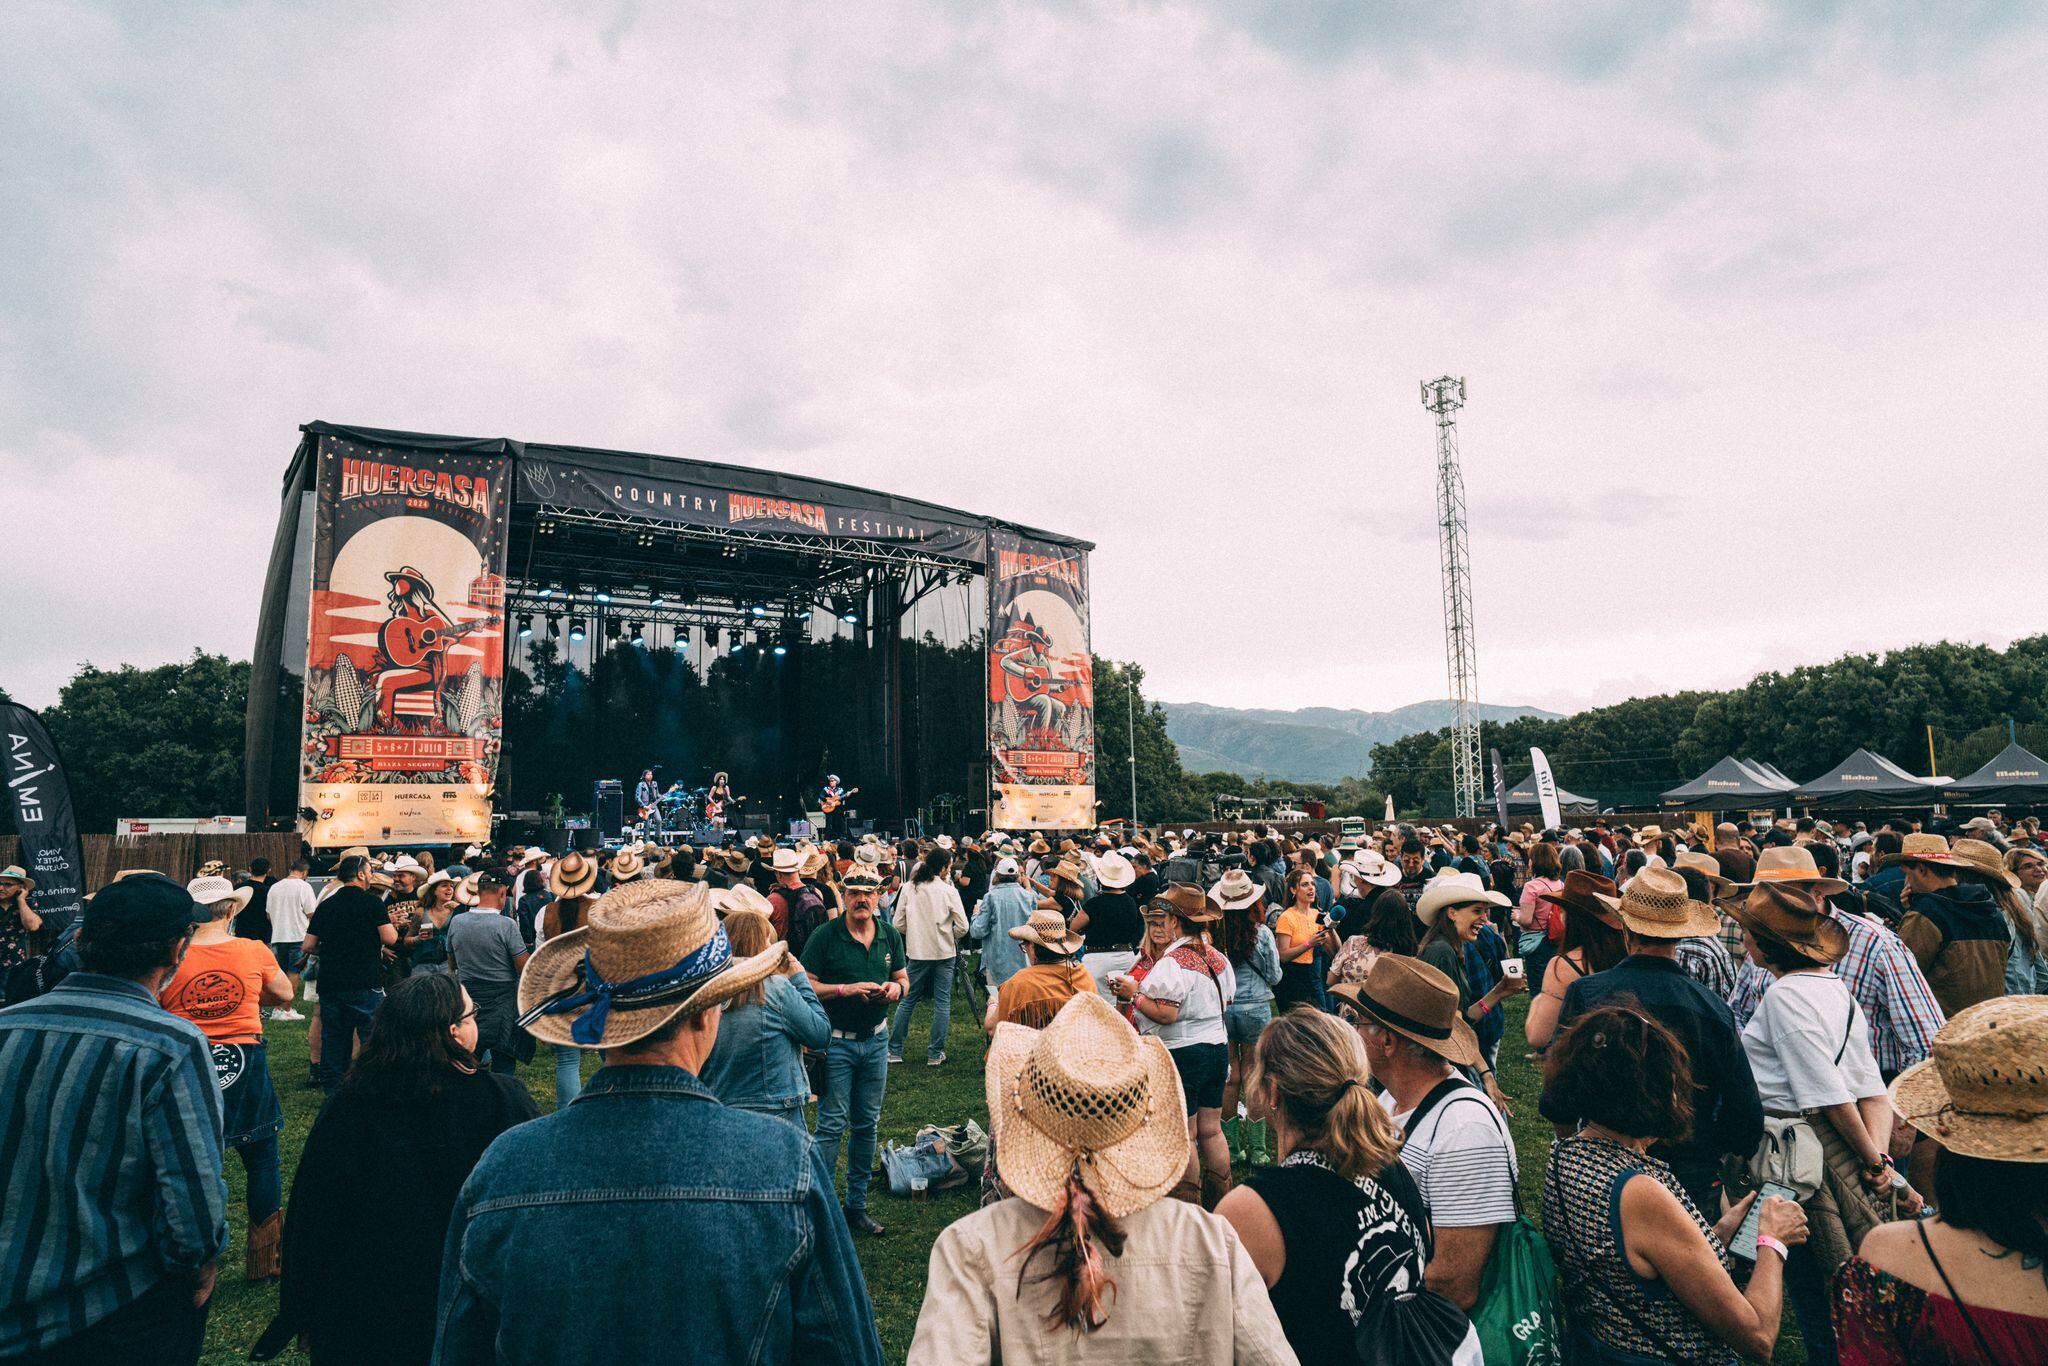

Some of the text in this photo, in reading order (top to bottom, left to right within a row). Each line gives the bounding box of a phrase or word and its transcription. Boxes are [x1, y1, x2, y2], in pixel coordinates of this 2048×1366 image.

[341, 458, 491, 520] HUERCASA
[352, 497, 399, 511] COUNTRY
[435, 504, 482, 528] FESTIVAL
[613, 485, 926, 542] COUNTRY HUERCASA FESTIVAL
[999, 549, 1082, 590] HUERCASA
[419, 744, 442, 753] JULIO
[394, 792, 432, 800] HUERCASA
[197, 995, 229, 1004] MAGIC
